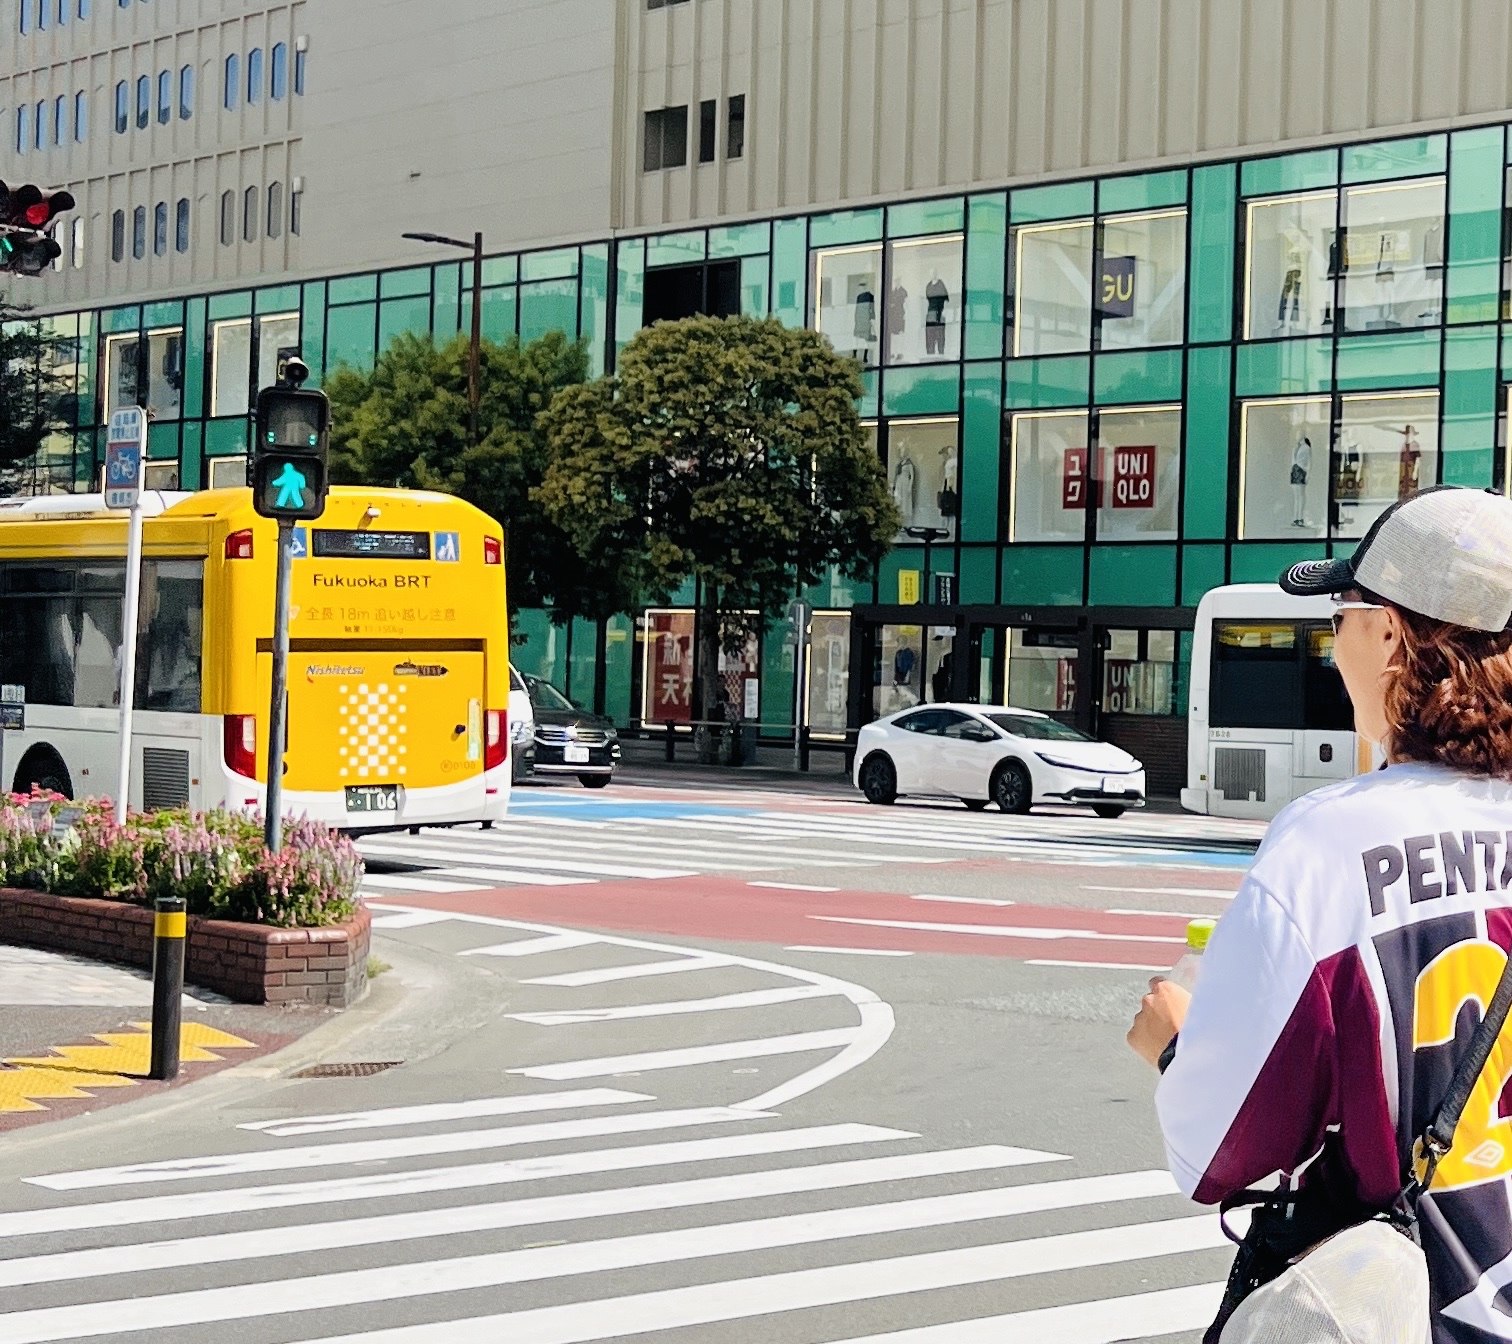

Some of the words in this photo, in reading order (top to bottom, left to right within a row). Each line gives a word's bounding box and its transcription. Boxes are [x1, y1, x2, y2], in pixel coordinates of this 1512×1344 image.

[1117, 452, 1149, 475] UNI
[1117, 478, 1150, 504] QLO
[313, 573, 388, 588] Fukuoka
[394, 574, 431, 589] BRT
